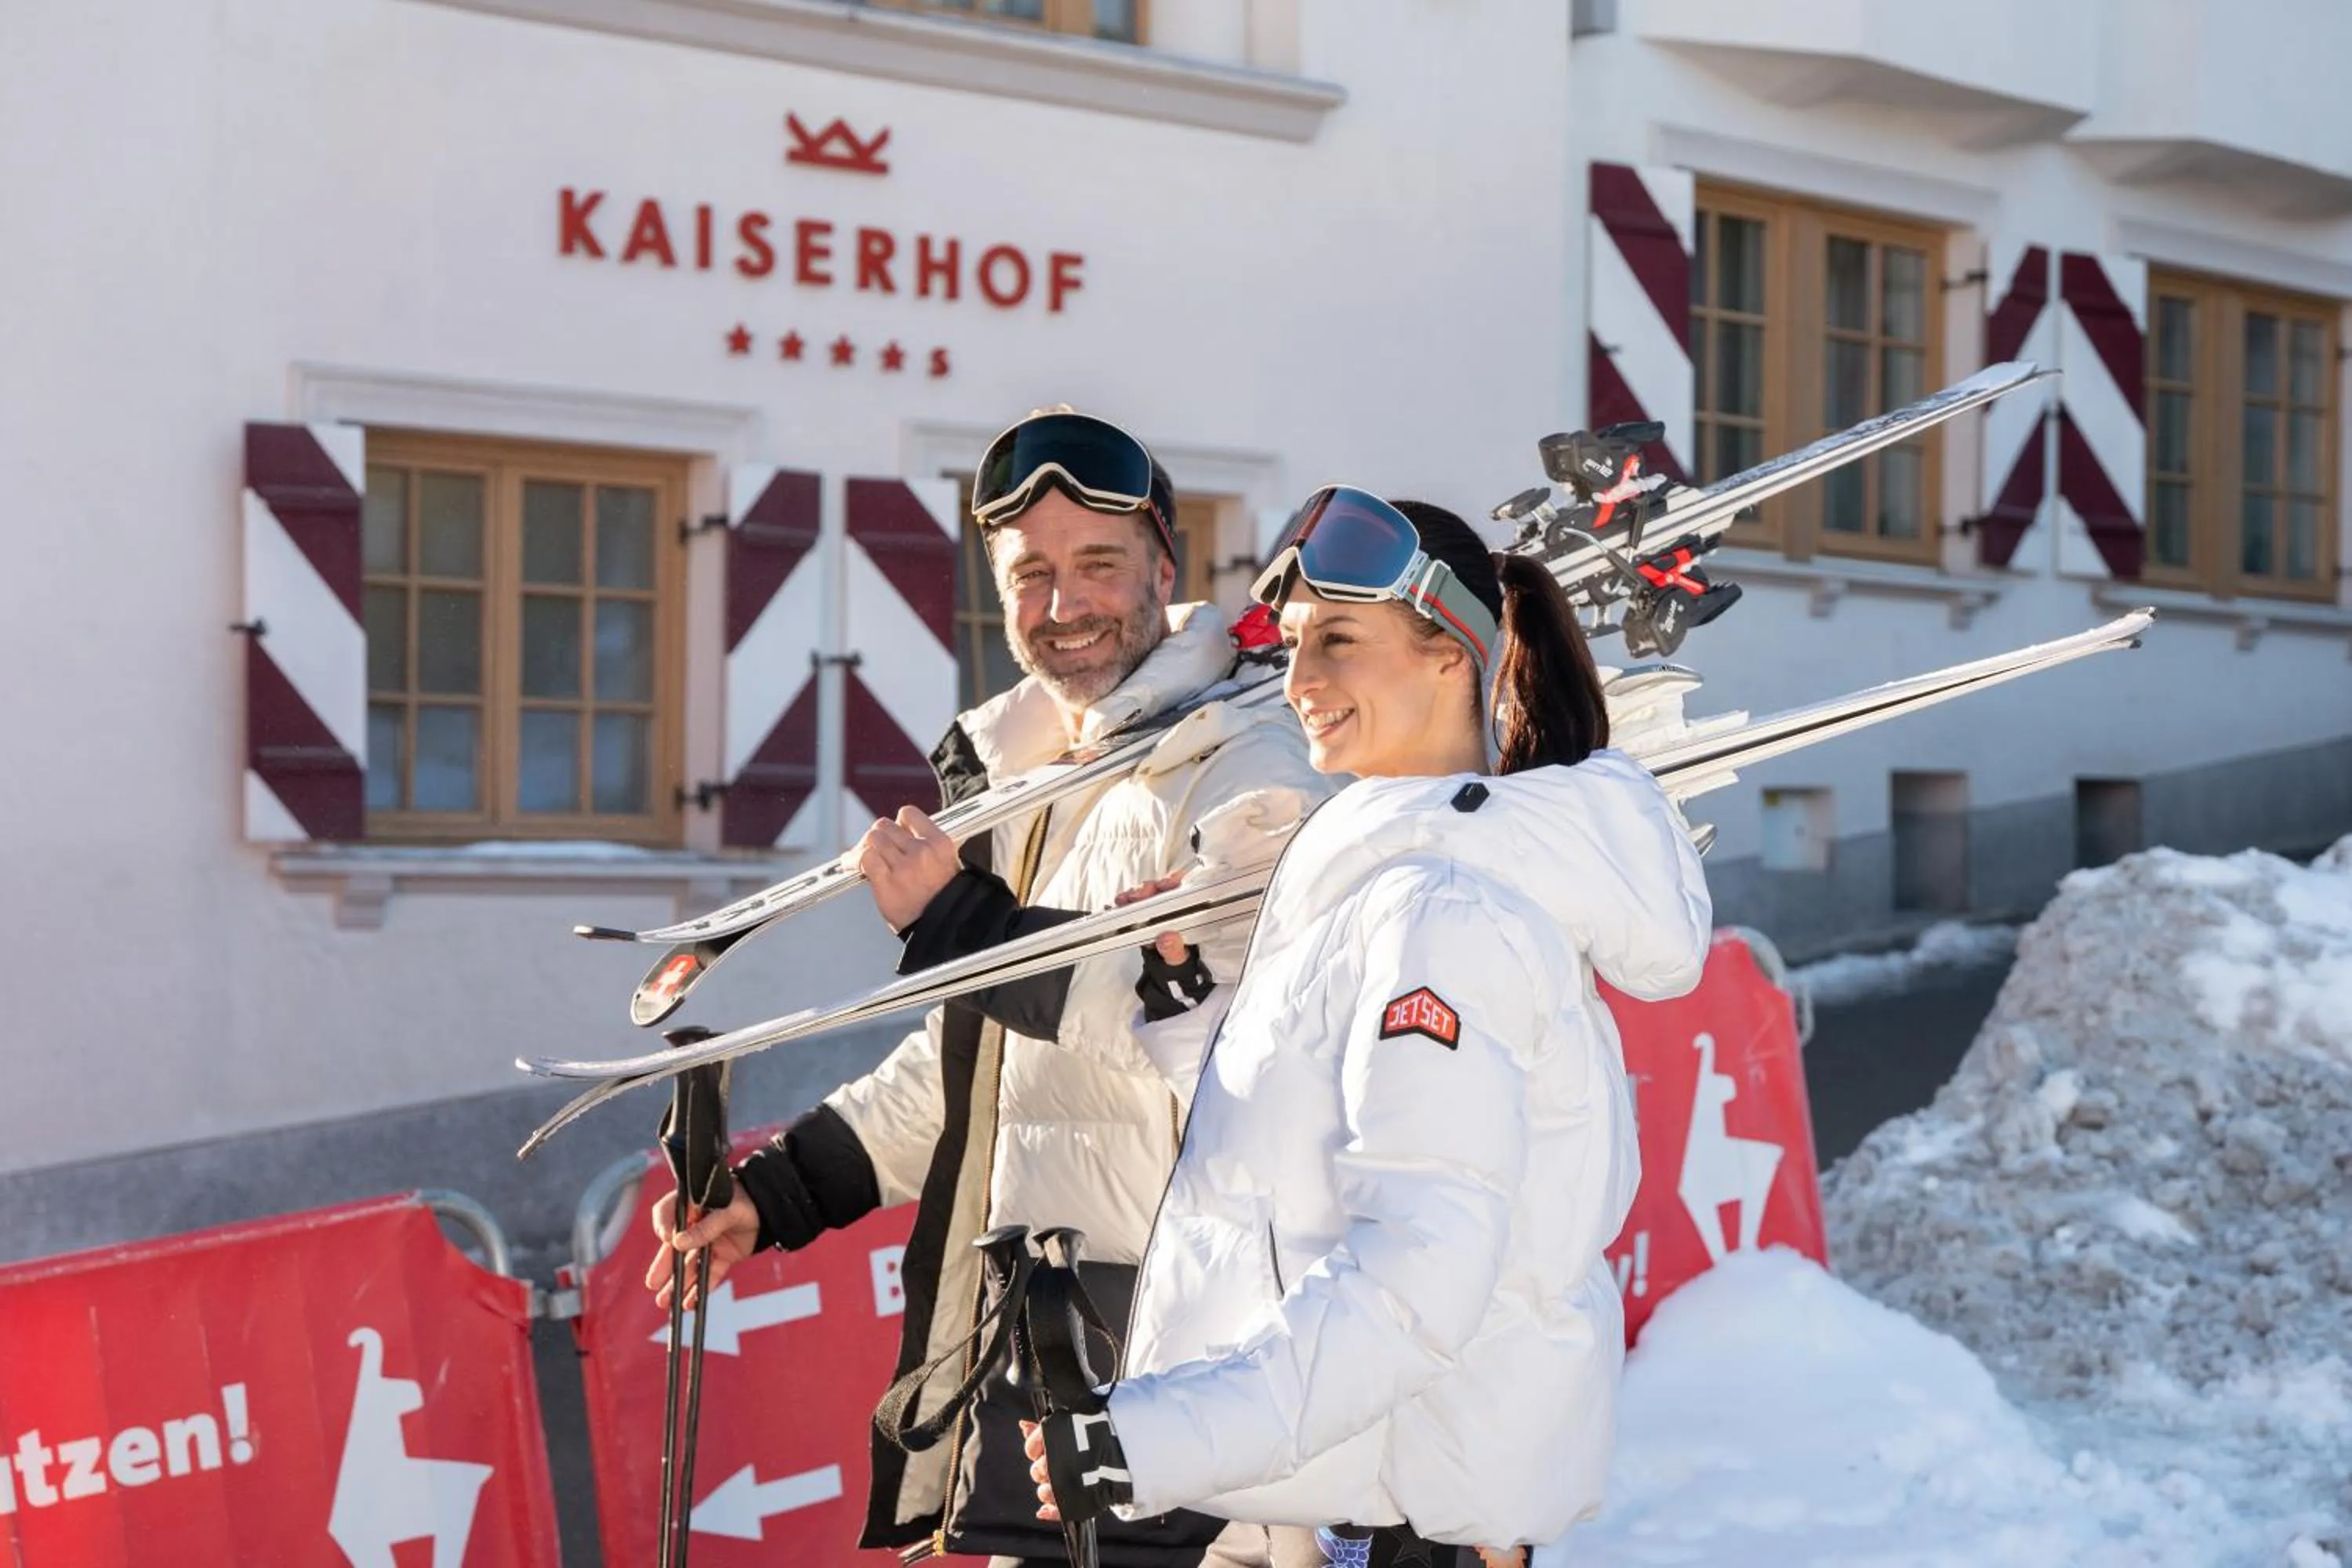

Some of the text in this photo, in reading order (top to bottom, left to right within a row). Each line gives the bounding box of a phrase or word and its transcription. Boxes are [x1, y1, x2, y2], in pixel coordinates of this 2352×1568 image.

[557, 187, 1084, 313] KAISERHOF
[928, 347, 950, 378] S
[1388, 994, 1450, 1034] JETSET
